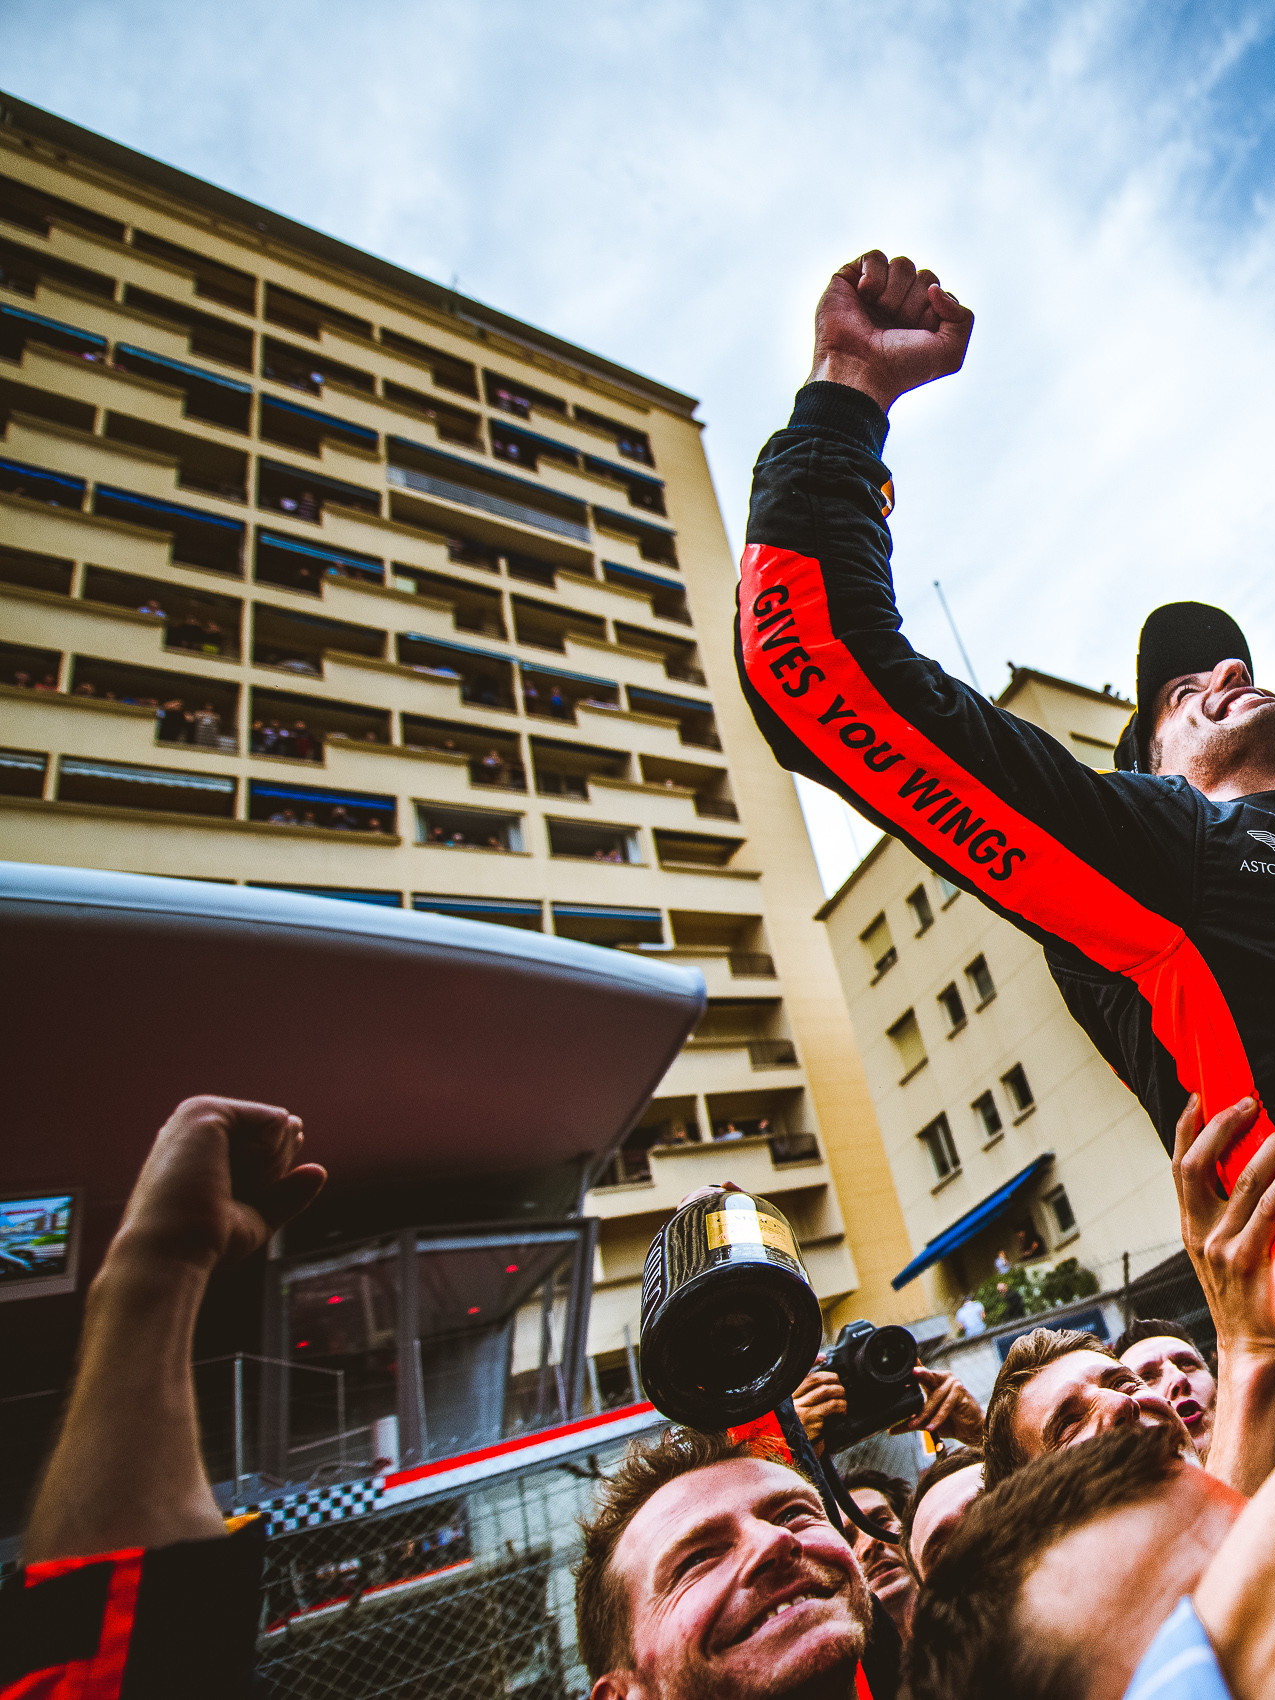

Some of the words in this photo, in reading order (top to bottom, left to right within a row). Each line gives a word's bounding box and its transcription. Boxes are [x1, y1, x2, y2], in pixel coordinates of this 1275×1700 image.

[753, 585, 826, 697] GIVES
[817, 694, 906, 773] YOU
[897, 768, 1026, 881] WINGS
[852, 1327, 873, 1338] Canon
